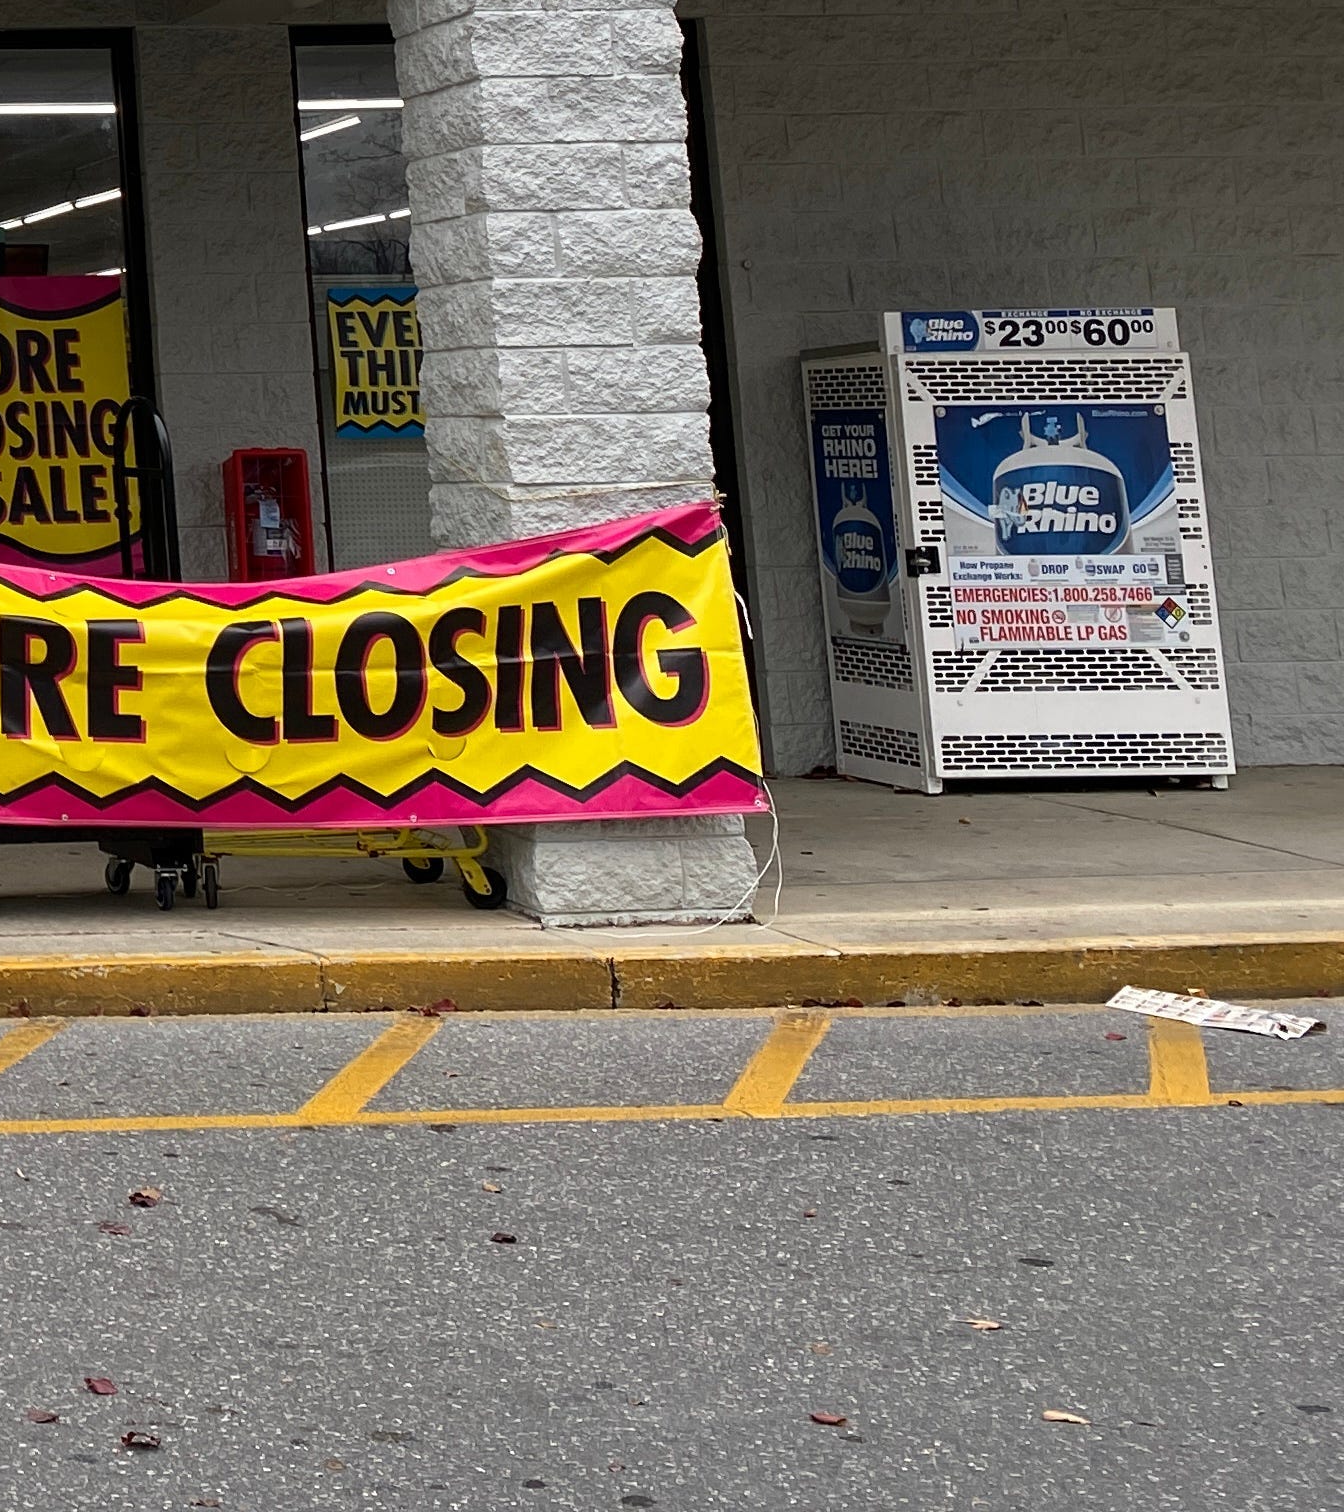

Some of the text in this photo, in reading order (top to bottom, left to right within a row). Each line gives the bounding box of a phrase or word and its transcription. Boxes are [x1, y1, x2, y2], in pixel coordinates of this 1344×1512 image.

[335, 311, 422, 348] EVE
[928, 319, 964, 330] Blue
[343, 391, 420, 416] MUST
[821, 425, 875, 437] GET YOUR
[823, 439, 877, 457] RHINO
[824, 459, 879, 478] HERE!
[1022, 480, 1100, 506] Blue
[1017, 506, 1117, 534] Rhino
[843, 532, 874, 550] Blue
[980, 562, 1014, 571] Propane
[1041, 565, 1069, 575] DROP
[1096, 565, 1125, 575] SWAP
[1132, 564, 1146, 574] GO
[953, 573, 992, 581] Exchange
[956, 610, 977, 625] NO
[982, 609, 1050, 624] SMOKING
[980, 625, 1127, 642] FLAMMABLE LP GAS
[205, 590, 710, 746] CLOSING
